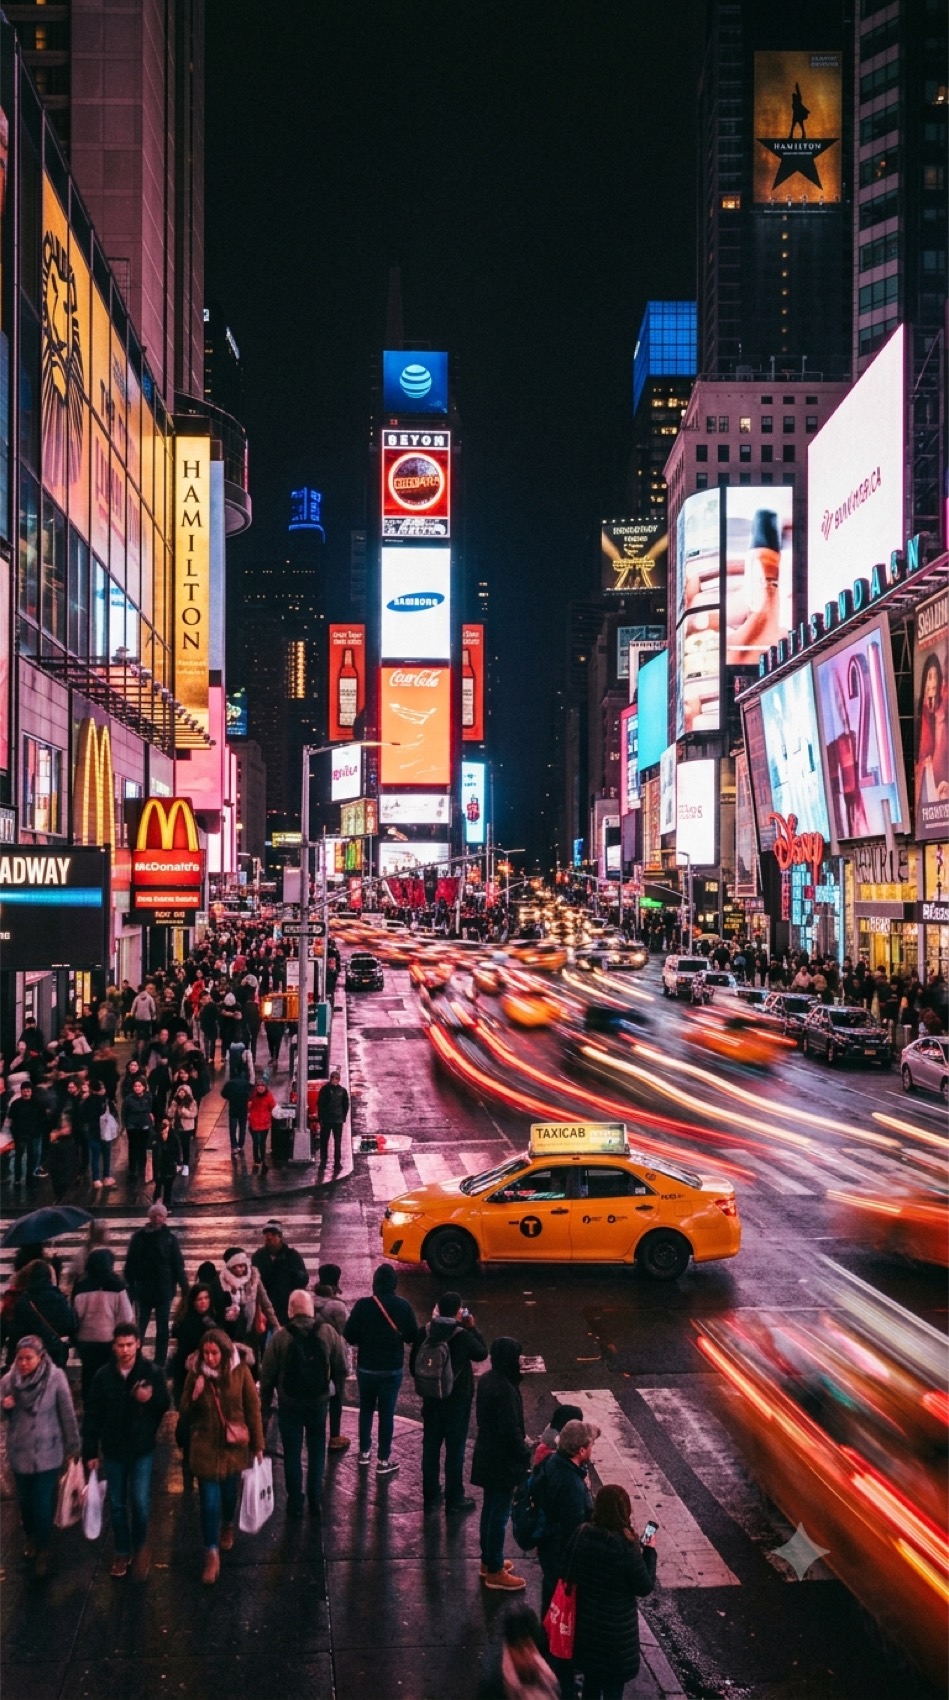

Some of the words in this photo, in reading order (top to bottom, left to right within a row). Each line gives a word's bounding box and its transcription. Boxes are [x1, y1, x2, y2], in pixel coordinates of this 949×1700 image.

[774, 142, 822, 150] HAMILTON
[181, 459, 203, 650] HAMILTON
[536, 1127, 586, 1139] TAXICAB
